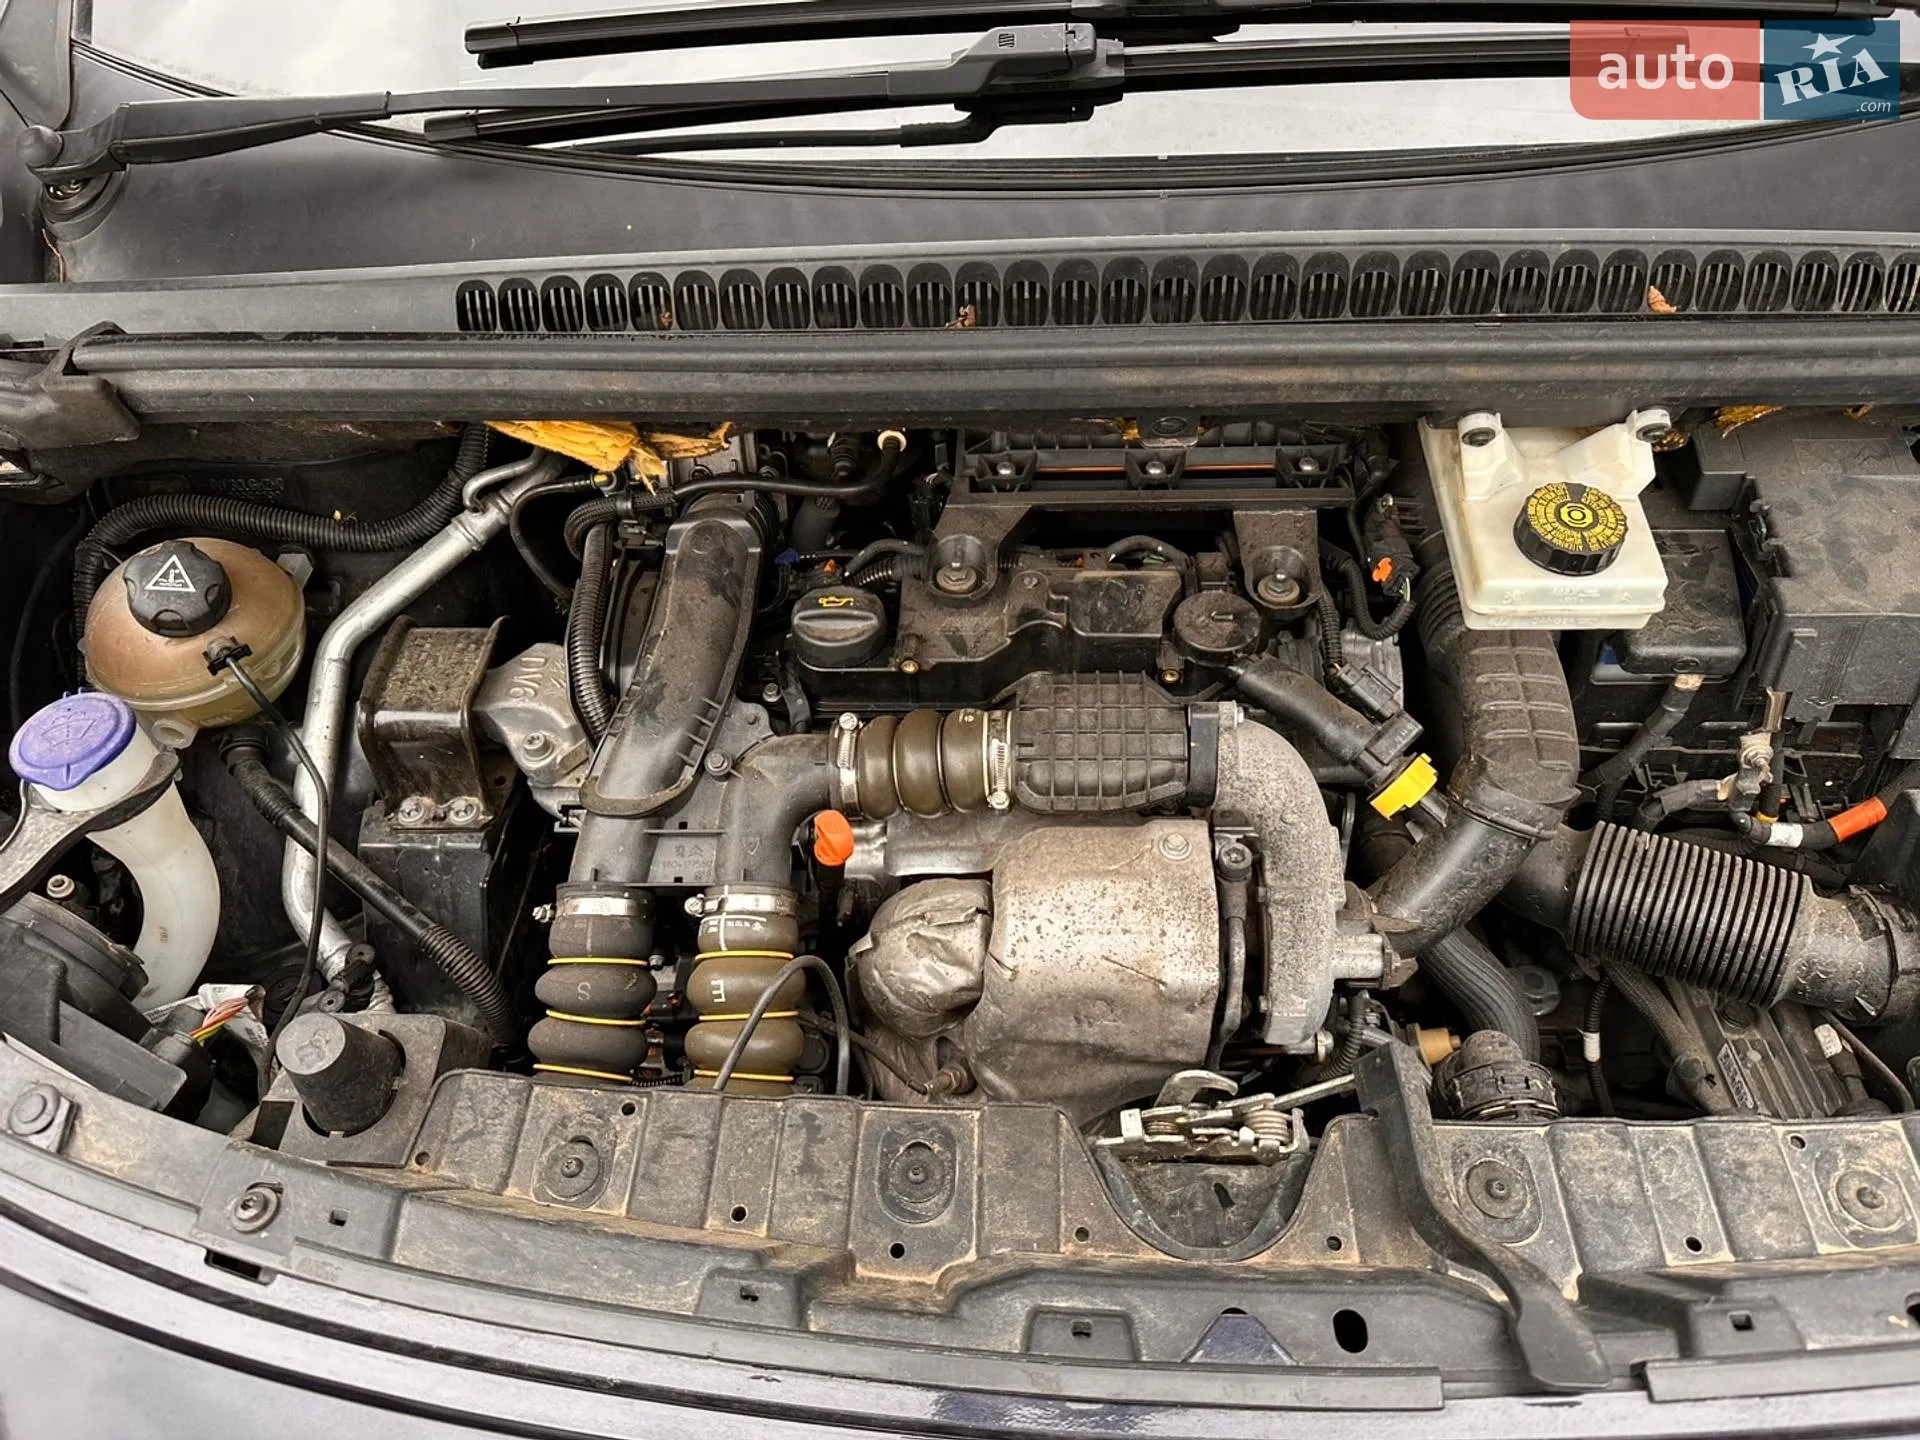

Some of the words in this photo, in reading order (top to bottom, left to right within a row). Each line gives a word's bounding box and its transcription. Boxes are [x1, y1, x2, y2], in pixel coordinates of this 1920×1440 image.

[508, 656, 547, 698] DV6
[577, 981, 592, 1001] S
[711, 979, 727, 1003] E
